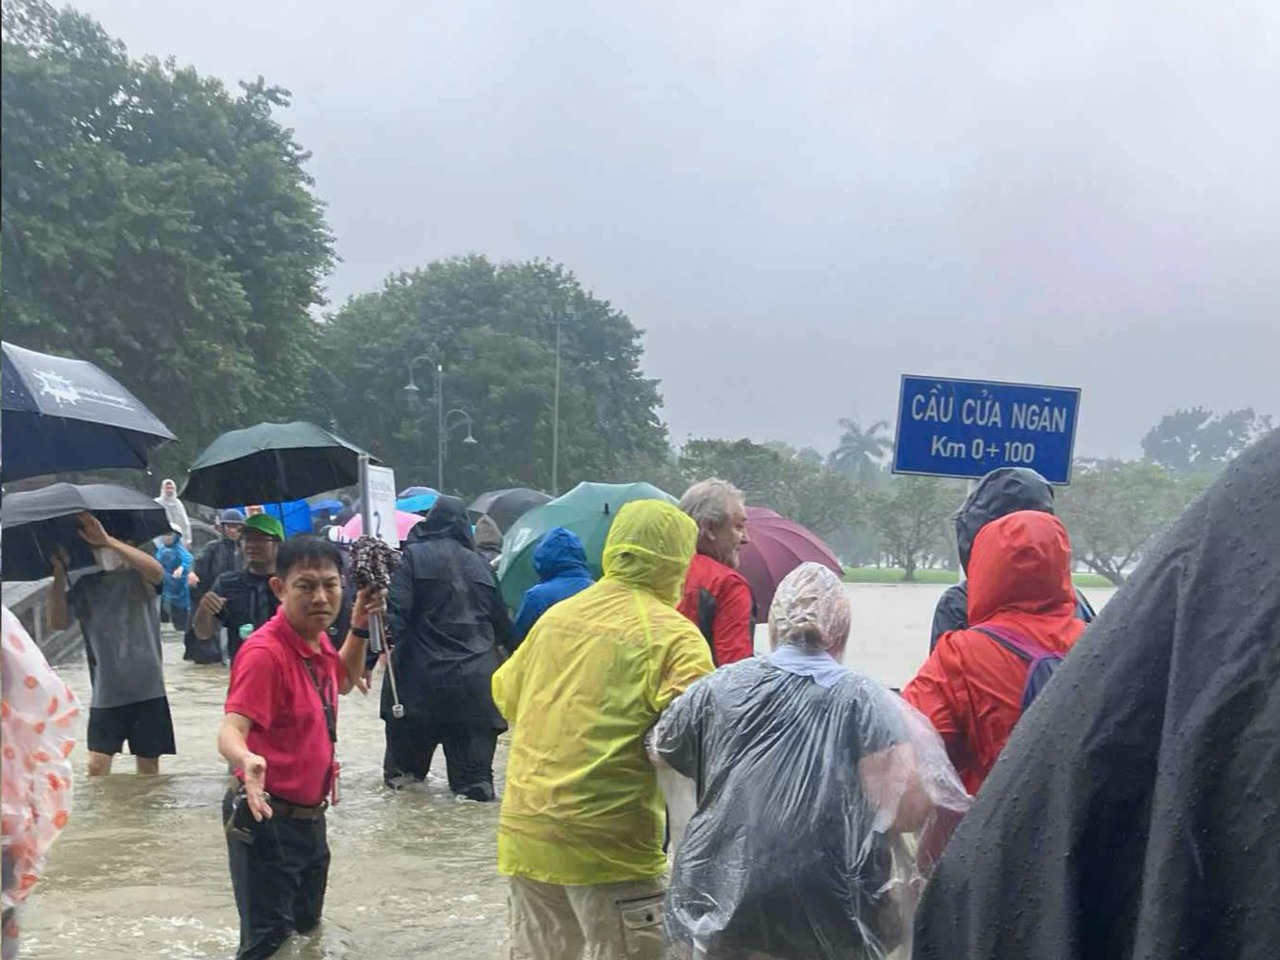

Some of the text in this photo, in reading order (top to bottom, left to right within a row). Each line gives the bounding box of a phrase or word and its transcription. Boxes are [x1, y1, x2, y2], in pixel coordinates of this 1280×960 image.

[912, 384, 1067, 433] CẦU CỬA NGĂN
[931, 435, 966, 459] Km
